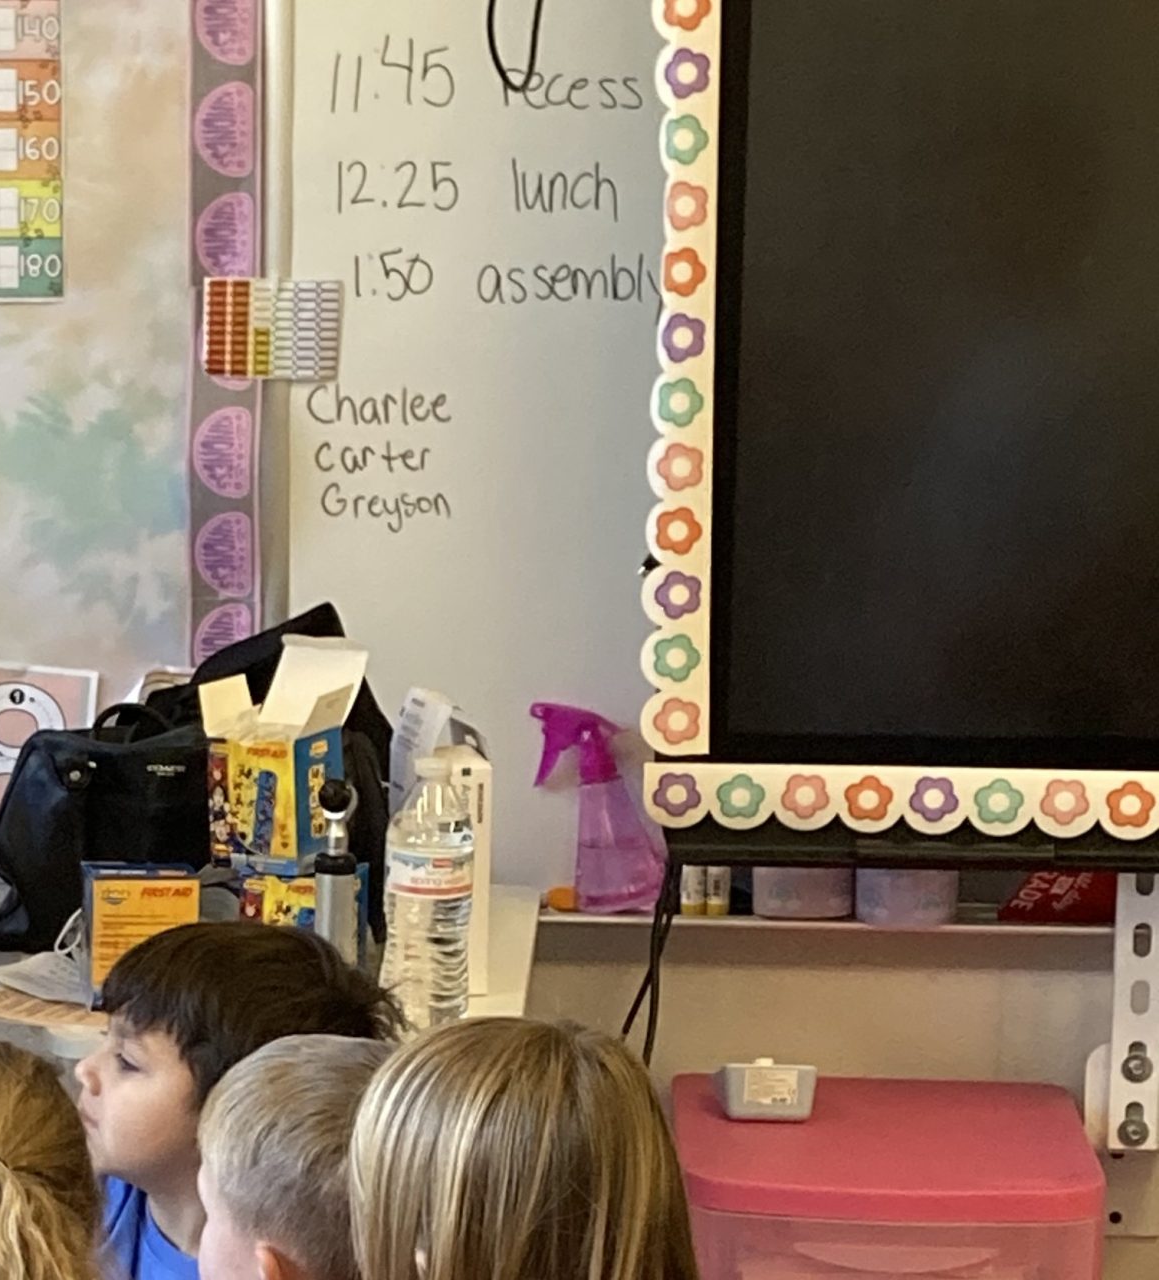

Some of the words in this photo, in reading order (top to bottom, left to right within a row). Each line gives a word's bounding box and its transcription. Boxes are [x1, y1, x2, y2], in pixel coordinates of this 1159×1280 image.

[17, 15, 60, 42] 140
[331, 34, 455, 113] 11:45
[17, 79, 61, 106] 150
[18, 137, 60, 161] 160
[511, 157, 619, 223] lunch
[20, 197, 61, 223] 170
[20, 254, 61, 278] 180
[306, 384, 453, 426] Charlee
[321, 482, 452, 533] Greyson
[141, 886, 171, 898] FIRST
[172, 886, 194, 897] AID
